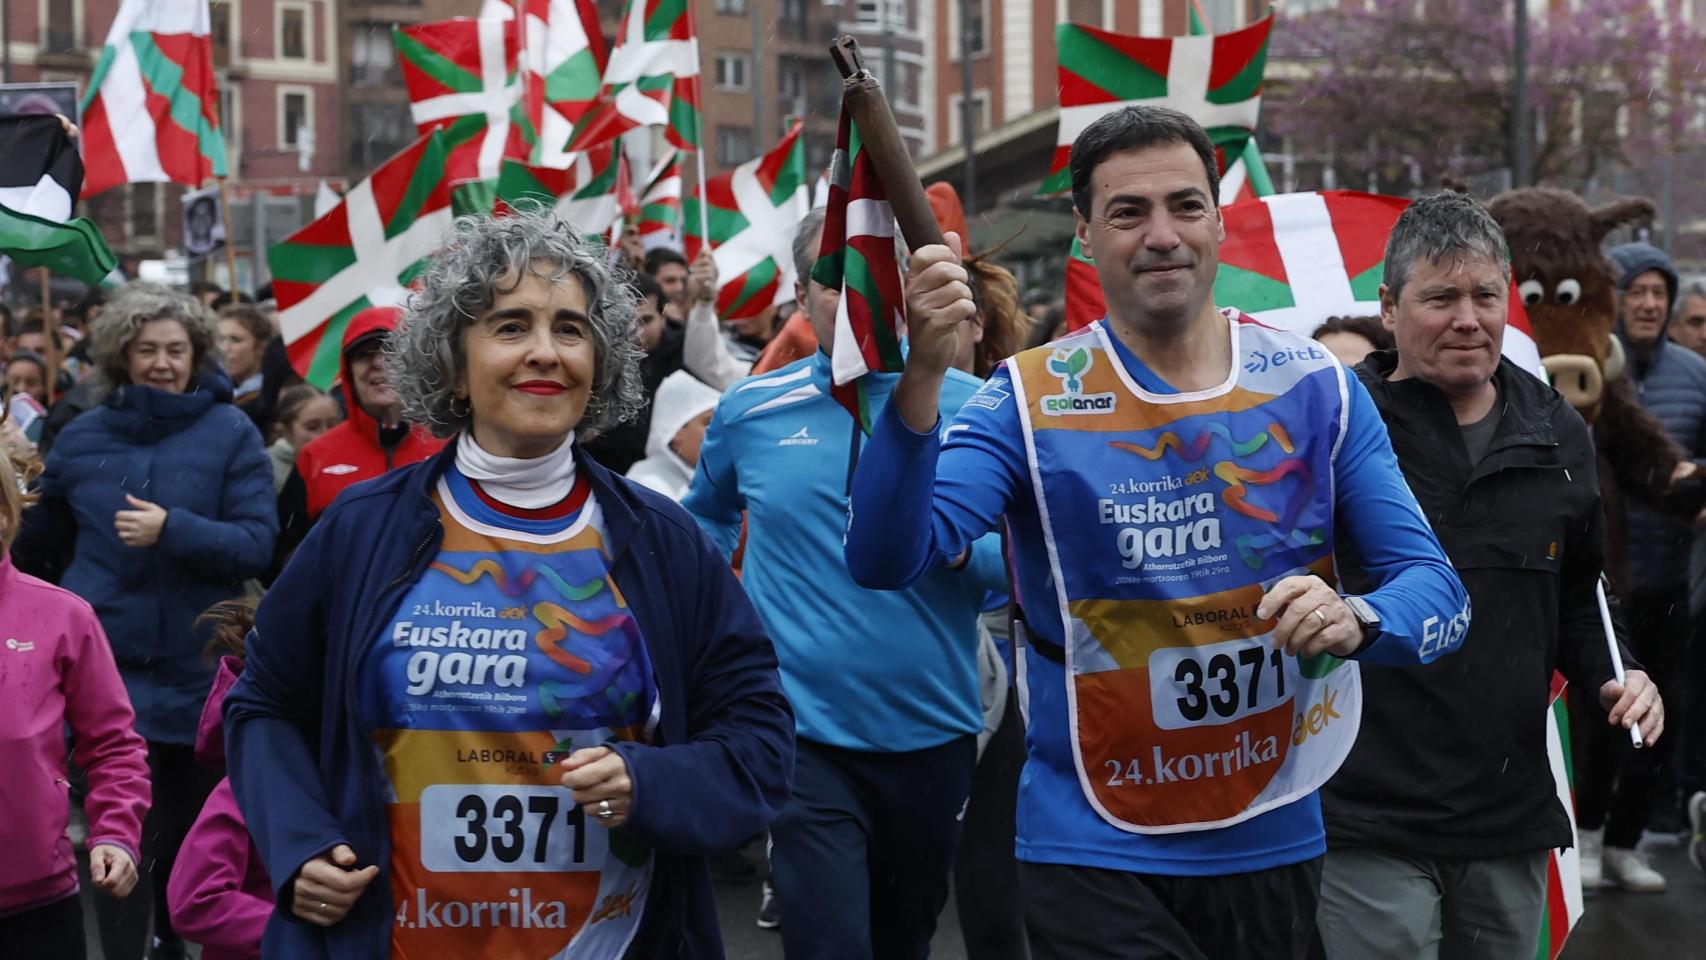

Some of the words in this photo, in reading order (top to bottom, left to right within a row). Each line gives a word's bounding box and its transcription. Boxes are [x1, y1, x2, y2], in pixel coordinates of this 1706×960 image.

[1271, 346, 1325, 367] eitb
[1111, 475, 1184, 495] 24.korrika
[1184, 468, 1211, 485] aek
[1098, 492, 1215, 524] Euskara
[1116, 517, 1222, 570] gara
[1197, 554, 1229, 565] Bilbora
[411, 600, 496, 618] 24.korrika
[1172, 606, 1249, 628] LABORAL
[392, 620, 528, 651] Euskara
[406, 650, 528, 696] gara
[1174, 646, 1286, 722] 3371
[1291, 684, 1341, 747] aek
[457, 748, 539, 764] LABORAL
[1104, 731, 1279, 787] 24.korrika
[454, 794, 586, 863] 3371
[396, 887, 567, 929] 4.korrika
